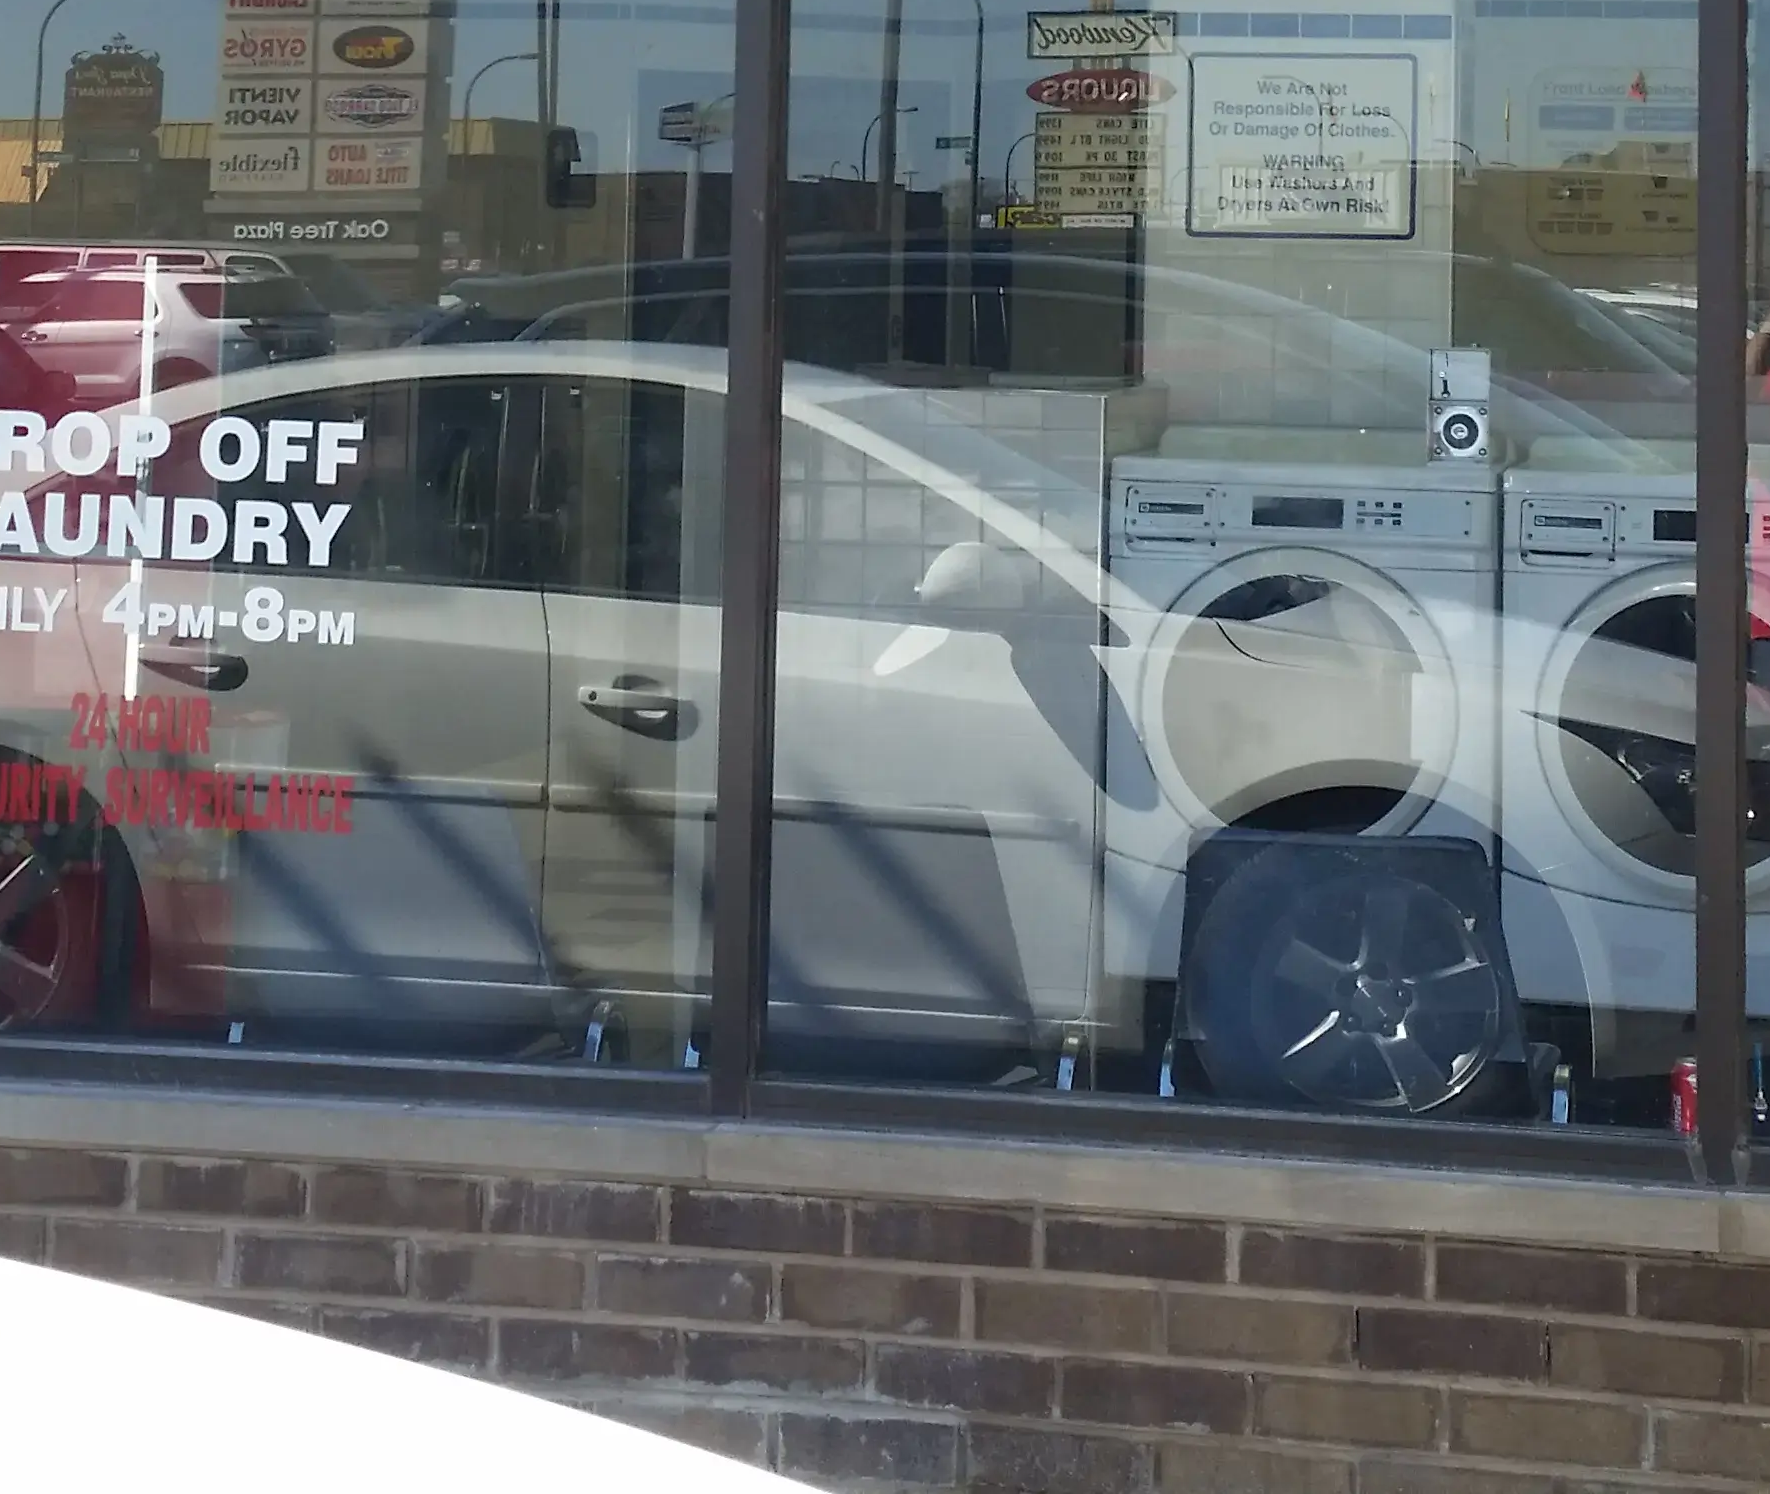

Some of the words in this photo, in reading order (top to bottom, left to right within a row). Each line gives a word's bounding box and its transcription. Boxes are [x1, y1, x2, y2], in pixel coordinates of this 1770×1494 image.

[1256, 80, 1282, 96] We
[1286, 80, 1315, 96] Are
[1319, 81, 1348, 96] Not
[1213, 100, 1314, 118] Responsible
[1318, 102, 1347, 117] For
[1351, 103, 1391, 117] Loss
[1208, 122, 1228, 137] Or
[1233, 122, 1299, 141] Damage
[1262, 154, 1346, 171] WARNING
[1231, 175, 1262, 190] Use
[1341, 176, 1375, 191] And
[1302, 198, 1341, 213] Own
[198, 416, 366, 486] OFF
[102, 586, 356, 647] 4PM-8PM
[69, 692, 105, 750] 24
[115, 694, 213, 756] HOUR
[103, 766, 356, 835] SURVEILLANCE
